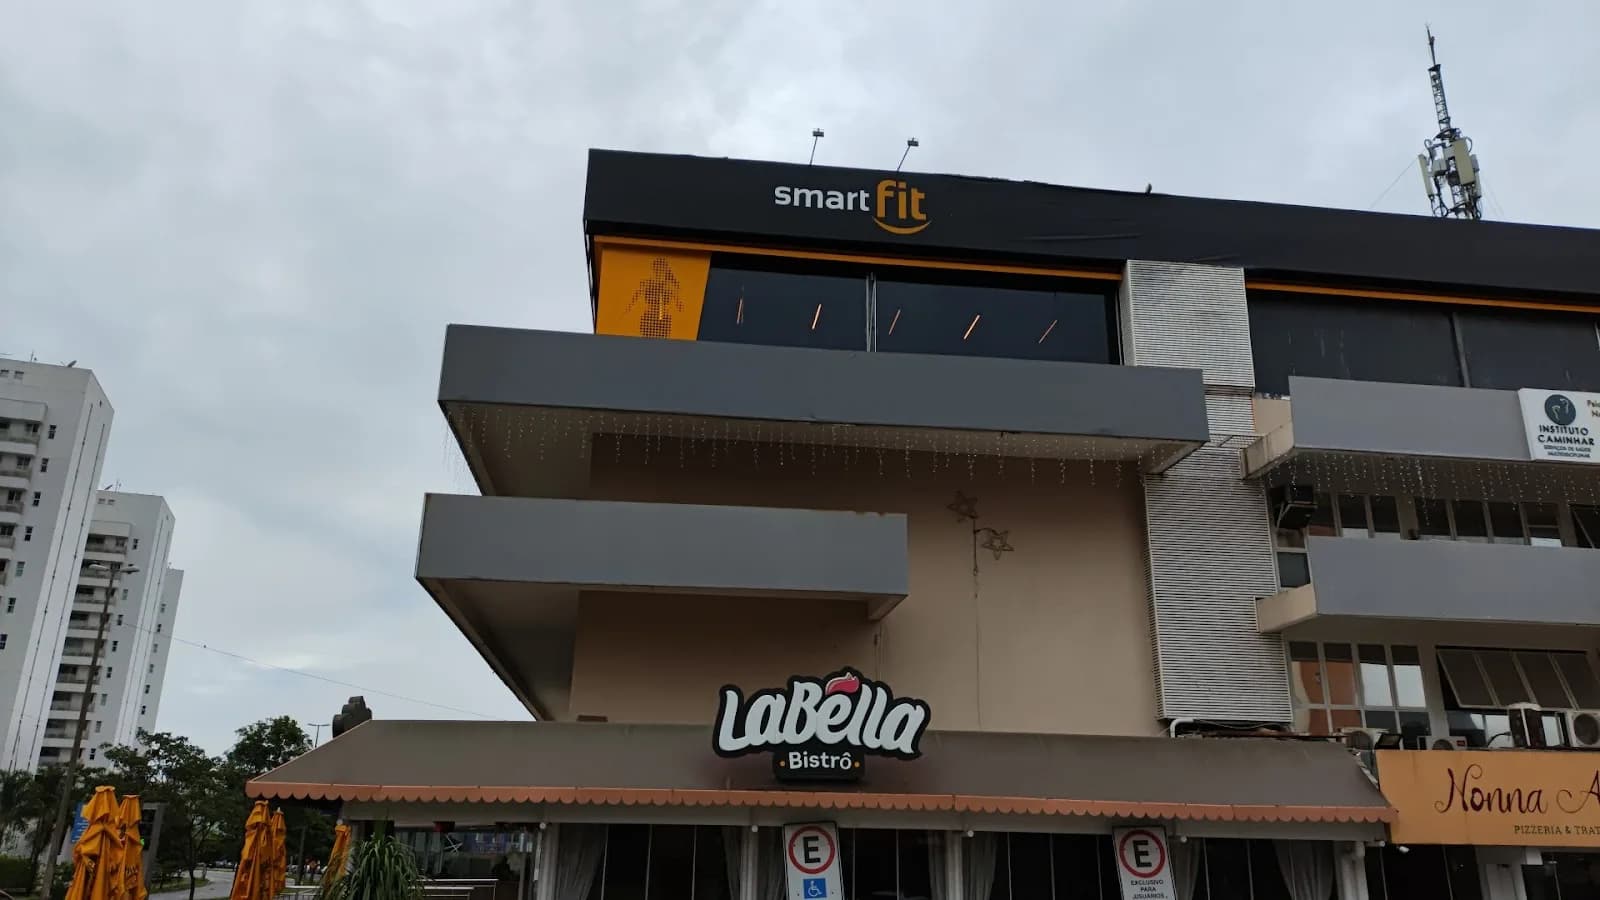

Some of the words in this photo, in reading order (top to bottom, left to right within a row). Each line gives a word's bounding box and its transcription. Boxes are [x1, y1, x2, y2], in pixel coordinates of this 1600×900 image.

[774, 185, 870, 212] smart
[876, 179, 927, 221] fit
[1537, 434, 1595, 446] CAMINHAR
[1539, 424, 1589, 436] INSTITUTO
[788, 751, 852, 770] Bistrô
[1434, 763, 1549, 815] Nonna
[1514, 825, 1562, 835] PIZZERIA
[1565, 825, 1572, 834] &
[803, 836, 821, 864] E
[1132, 840, 1152, 868] E
